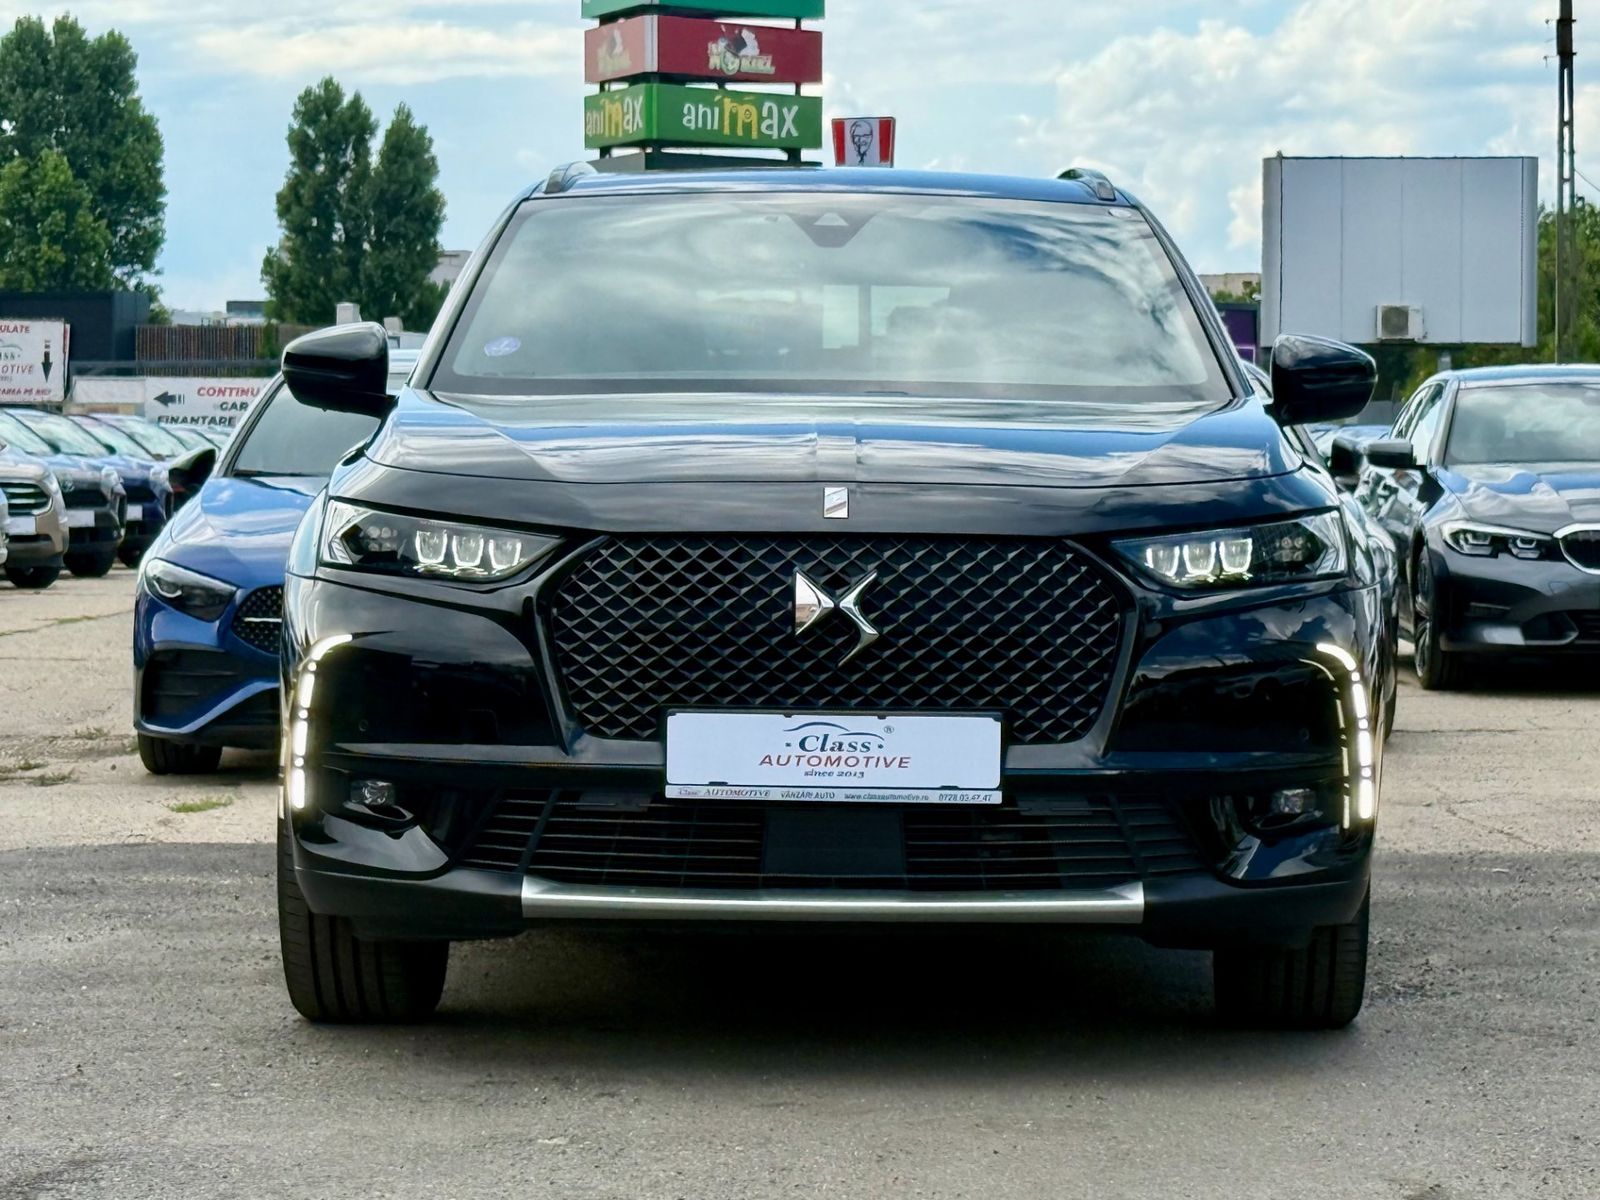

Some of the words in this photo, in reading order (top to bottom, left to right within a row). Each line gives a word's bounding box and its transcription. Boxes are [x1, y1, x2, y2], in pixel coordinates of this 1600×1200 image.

[585, 93, 643, 137] animax
[682, 95, 799, 140] animax
[798, 733, 872, 753] Class
[758, 754, 912, 769] AUTOMOTIVE
[803, 769, 834, 778] since
[836, 771, 865, 779] 2013
[703, 788, 770, 798] AUTOMOTIVE
[814, 791, 835, 800] AUTO
